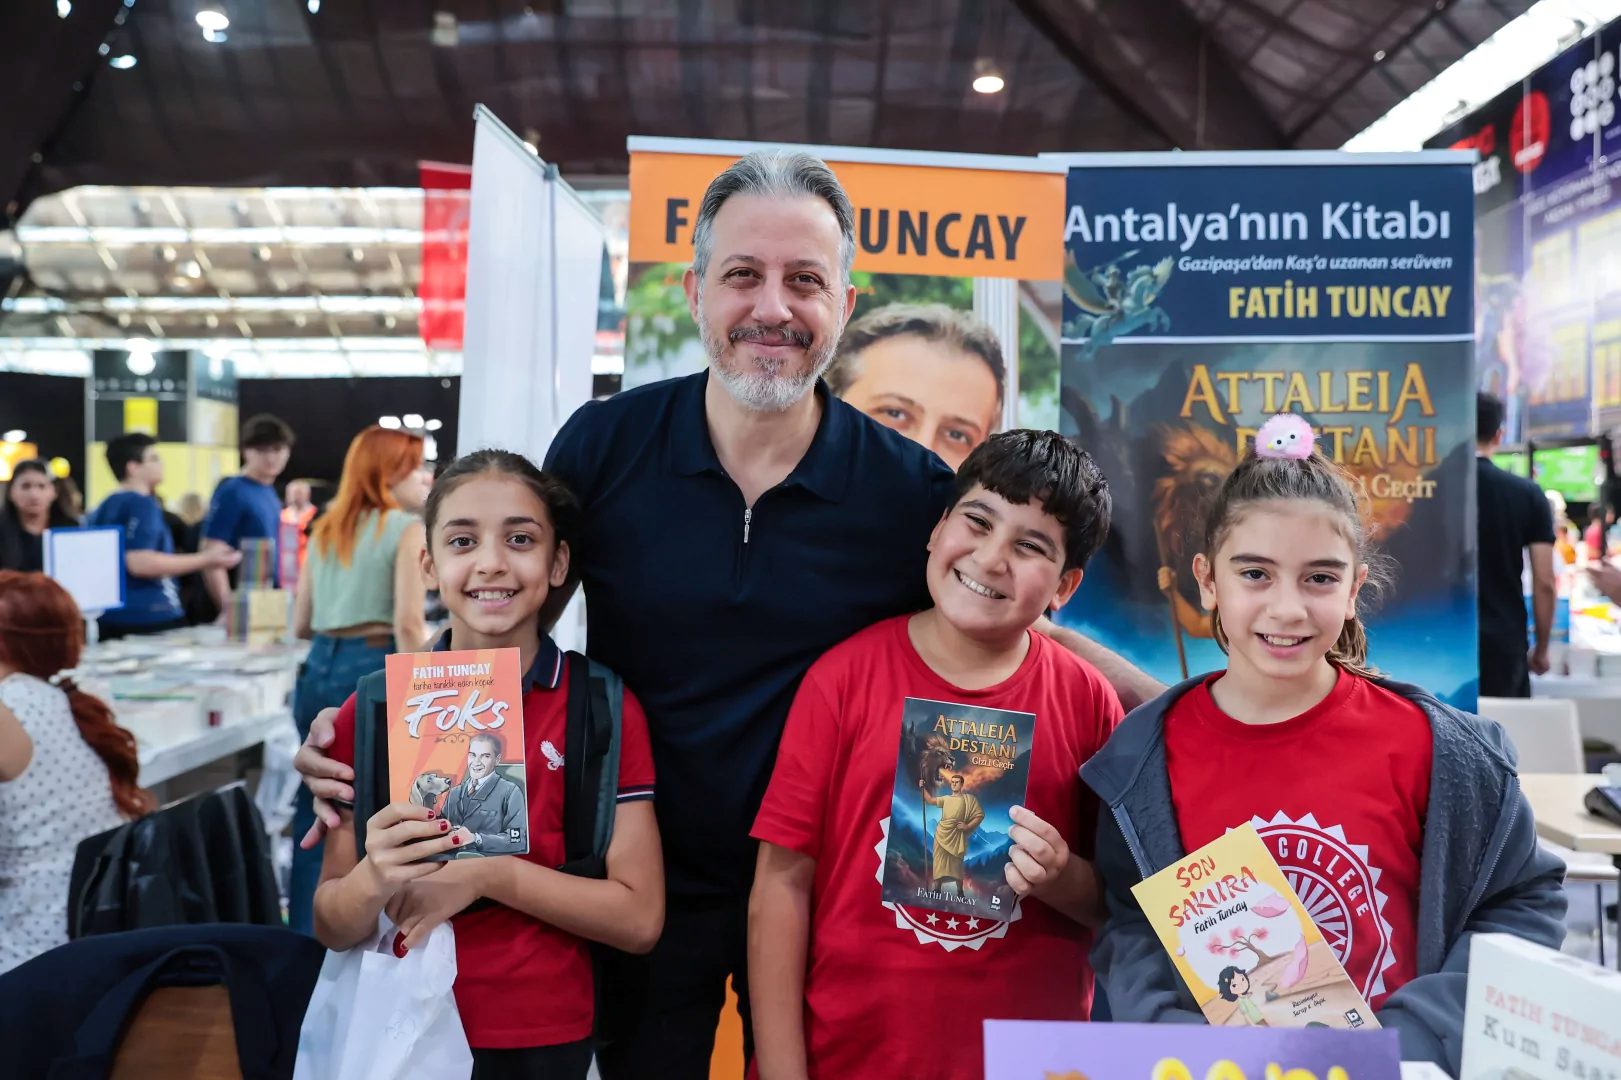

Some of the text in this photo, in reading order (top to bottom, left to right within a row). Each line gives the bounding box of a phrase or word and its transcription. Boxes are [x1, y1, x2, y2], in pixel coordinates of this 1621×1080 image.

[856, 208, 1027, 261] UNCAY
[1064, 201, 1451, 251] Antalya'nın Kitabı
[1178, 255, 1452, 273] Gazipaşa'dan Kaş'a uzanan serüven
[1229, 280, 1452, 319] FATİH TUNCAY
[1180, 362, 1436, 425] ATTALEIA
[447, 663, 491, 677] TUNCAY
[933, 715, 1017, 743] ATTALEIA
[949, 737, 1017, 759] DESTANI
[1175, 855, 1216, 888] SON
[1278, 836, 1371, 917] COLLEGE
[1169, 865, 1260, 928] SAKURA
[1194, 901, 1248, 934] Fatih Tuncay
[1482, 1014, 1541, 1060] Kum
